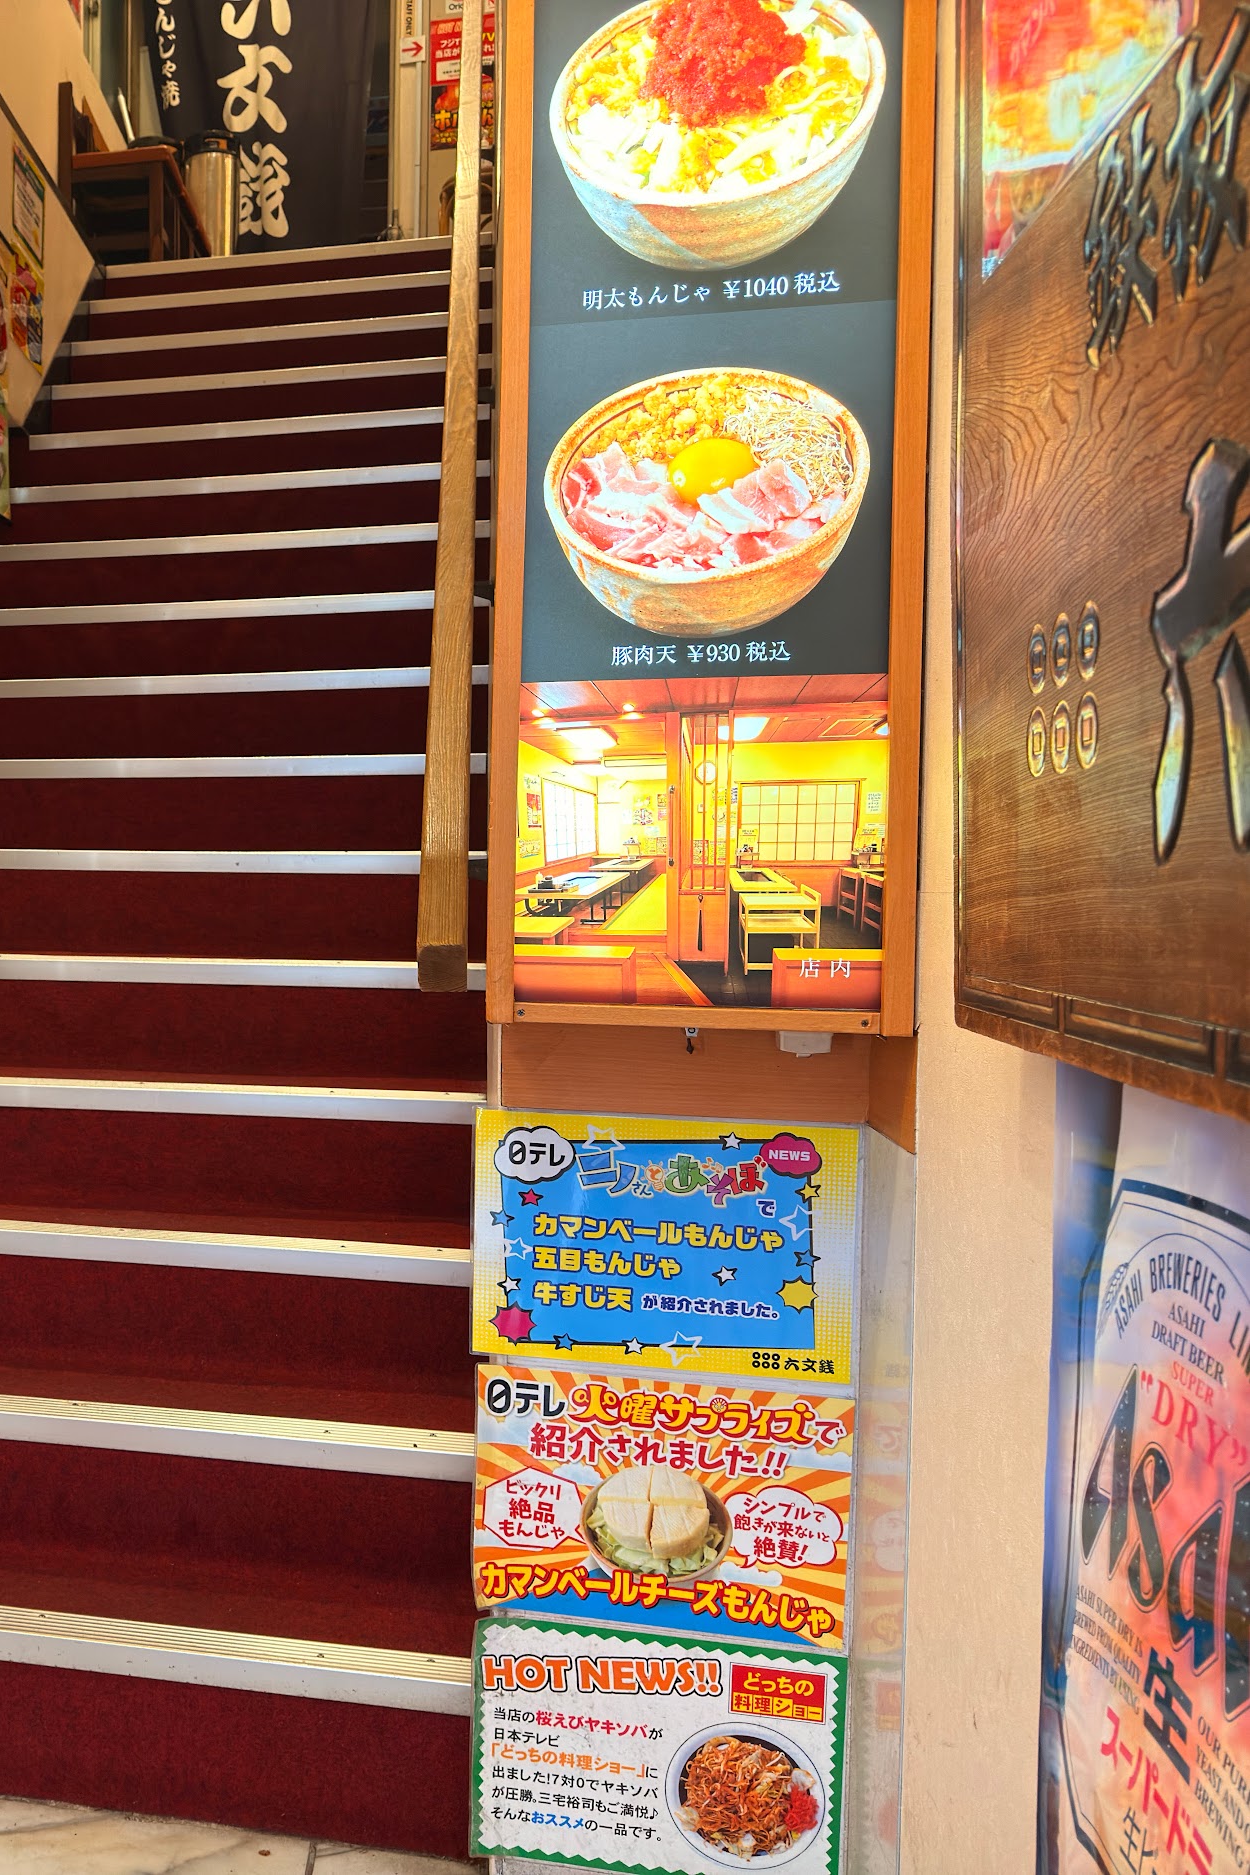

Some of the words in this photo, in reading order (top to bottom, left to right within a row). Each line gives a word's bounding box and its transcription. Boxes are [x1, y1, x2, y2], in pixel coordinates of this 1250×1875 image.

[155, 0, 180, 110] んじゃ焼
[582, 283, 711, 311] 明太もんじゃ
[722, 275, 789, 300] ¥1040
[793, 270, 841, 295] 税込
[611, 643, 677, 666] 豚肉天
[687, 643, 741, 663] ¥930
[745, 640, 792, 662] 税込
[799, 957, 851, 978] 店内
[768, 1147, 811, 1162] NEWS
[756, 1199, 776, 1218] で
[533, 1213, 784, 1253] カマンベールもんじゃ
[532, 1245, 682, 1280] 五目もんじゃ
[532, 1280, 634, 1313] 牛すじ天
[641, 1294, 780, 1321] が紹介されました。
[1114, 1269, 1144, 1340] ASAHI
[1150, 1252, 1226, 1323] BREWERIES
[1168, 1302, 1206, 1339] ASAHI
[783, 1356, 836, 1375] 六文銭
[1151, 1320, 1188, 1357] DRAFT
[1188, 1343, 1225, 1385] BEER
[1171, 1361, 1215, 1409] SUPER
[505, 1478, 562, 1499] ビックリ
[508, 1498, 556, 1524] 絶品
[742, 1495, 827, 1523] シンプルで
[498, 1519, 566, 1541] もんじゃ
[733, 1513, 831, 1544] 飽きが来ないと
[753, 1536, 808, 1563] 絶賛!
[480, 1562, 836, 1638] カマンベールチーズもんじゃ
[1096, 1596, 1118, 1630] SUPER
[1117, 1618, 1135, 1647] DRY
[484, 1656, 568, 1692] HOT
[577, 1656, 724, 1696] NEWS!!
[742, 1670, 815, 1698] どっちの
[493, 1706, 664, 1741] 当店の桜えびヤキソバが
[733, 1693, 825, 1723] 料理ショー
[1143, 1646, 1194, 1786] 生
[493, 1728, 560, 1748] 日本テレビ
[1197, 1716, 1221, 1760] OUR
[1195, 1743, 1223, 1794] YEAST
[1222, 1786, 1244, 1830] AND
[490, 1806, 663, 1843] そんなおススメの一品です。
[1194, 1778, 1244, 1869] BREWING
